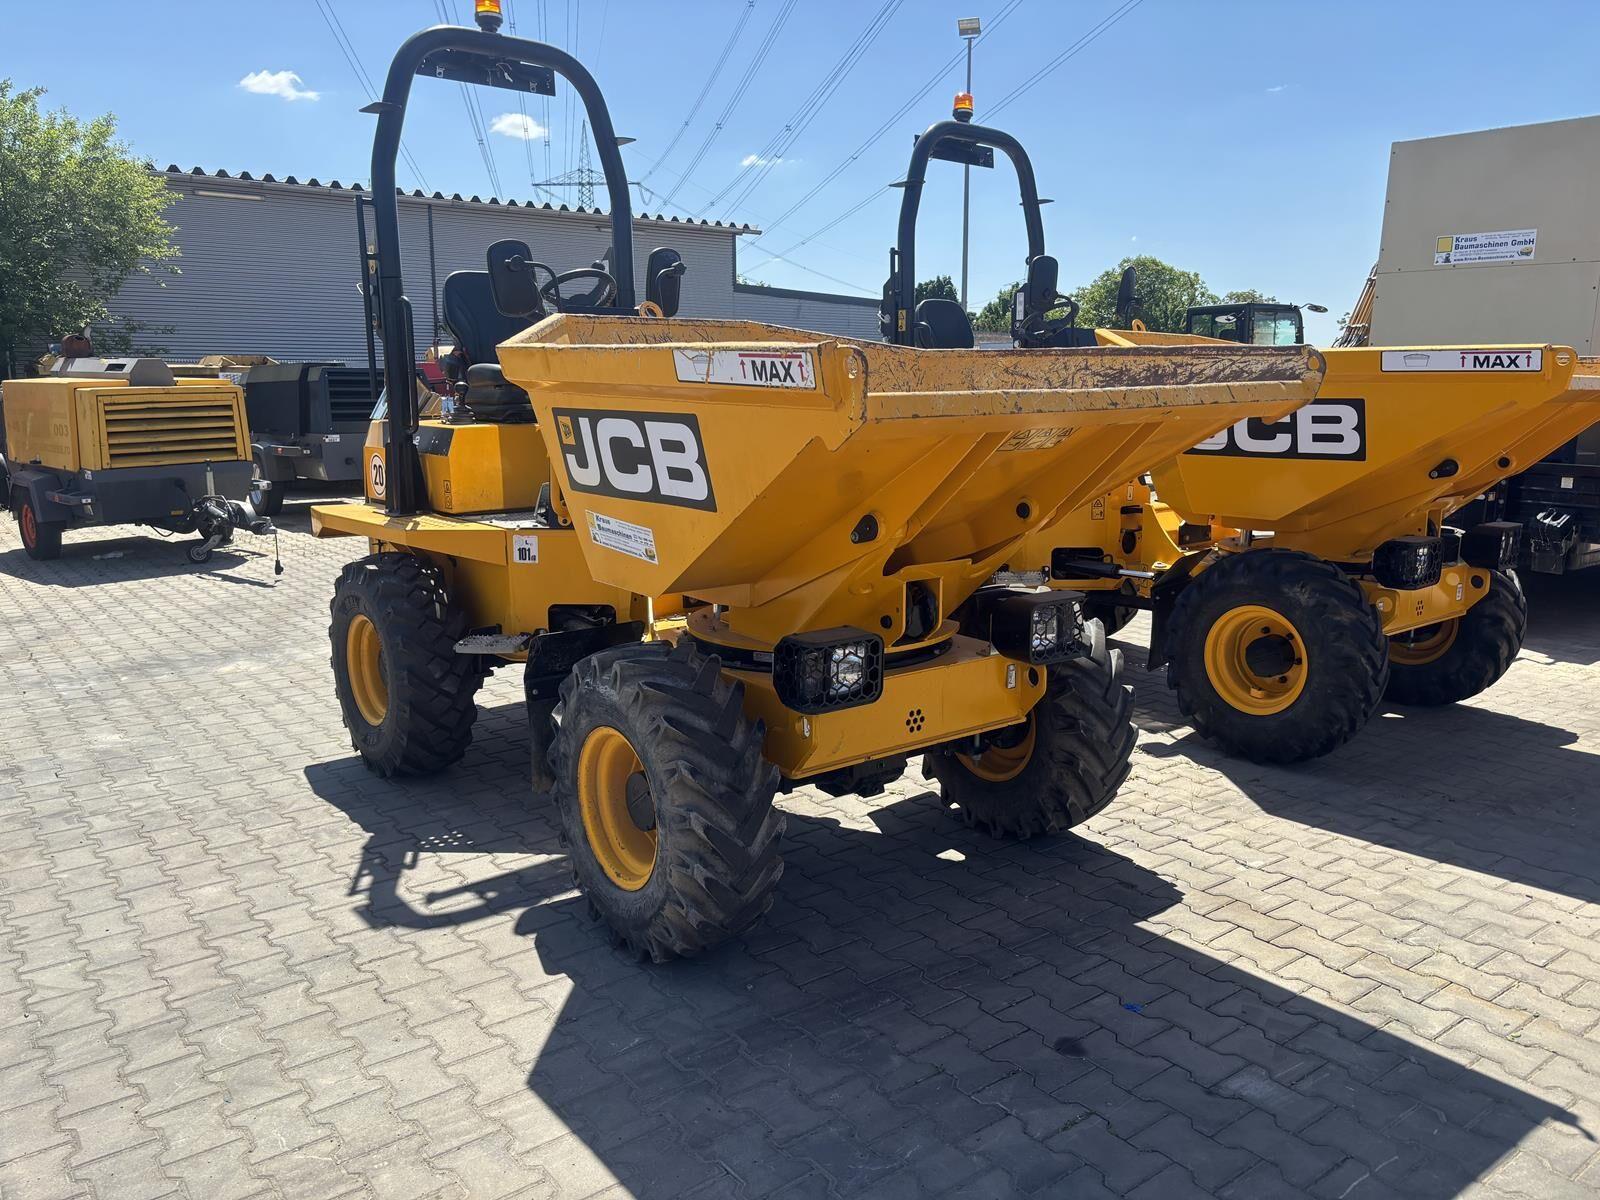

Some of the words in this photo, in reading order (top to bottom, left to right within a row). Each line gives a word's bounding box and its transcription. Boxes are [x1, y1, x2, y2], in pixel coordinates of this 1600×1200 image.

[1454, 241, 1508, 251] Baumaschinen
[1511, 238, 1535, 246] GmbH
[1472, 355, 1520, 368] MAX
[751, 359, 795, 383] MAX
[565, 417, 708, 500] JCB
[373, 463, 384, 487] 20
[595, 515, 611, 525] Kraus
[517, 547, 531, 561] 101
